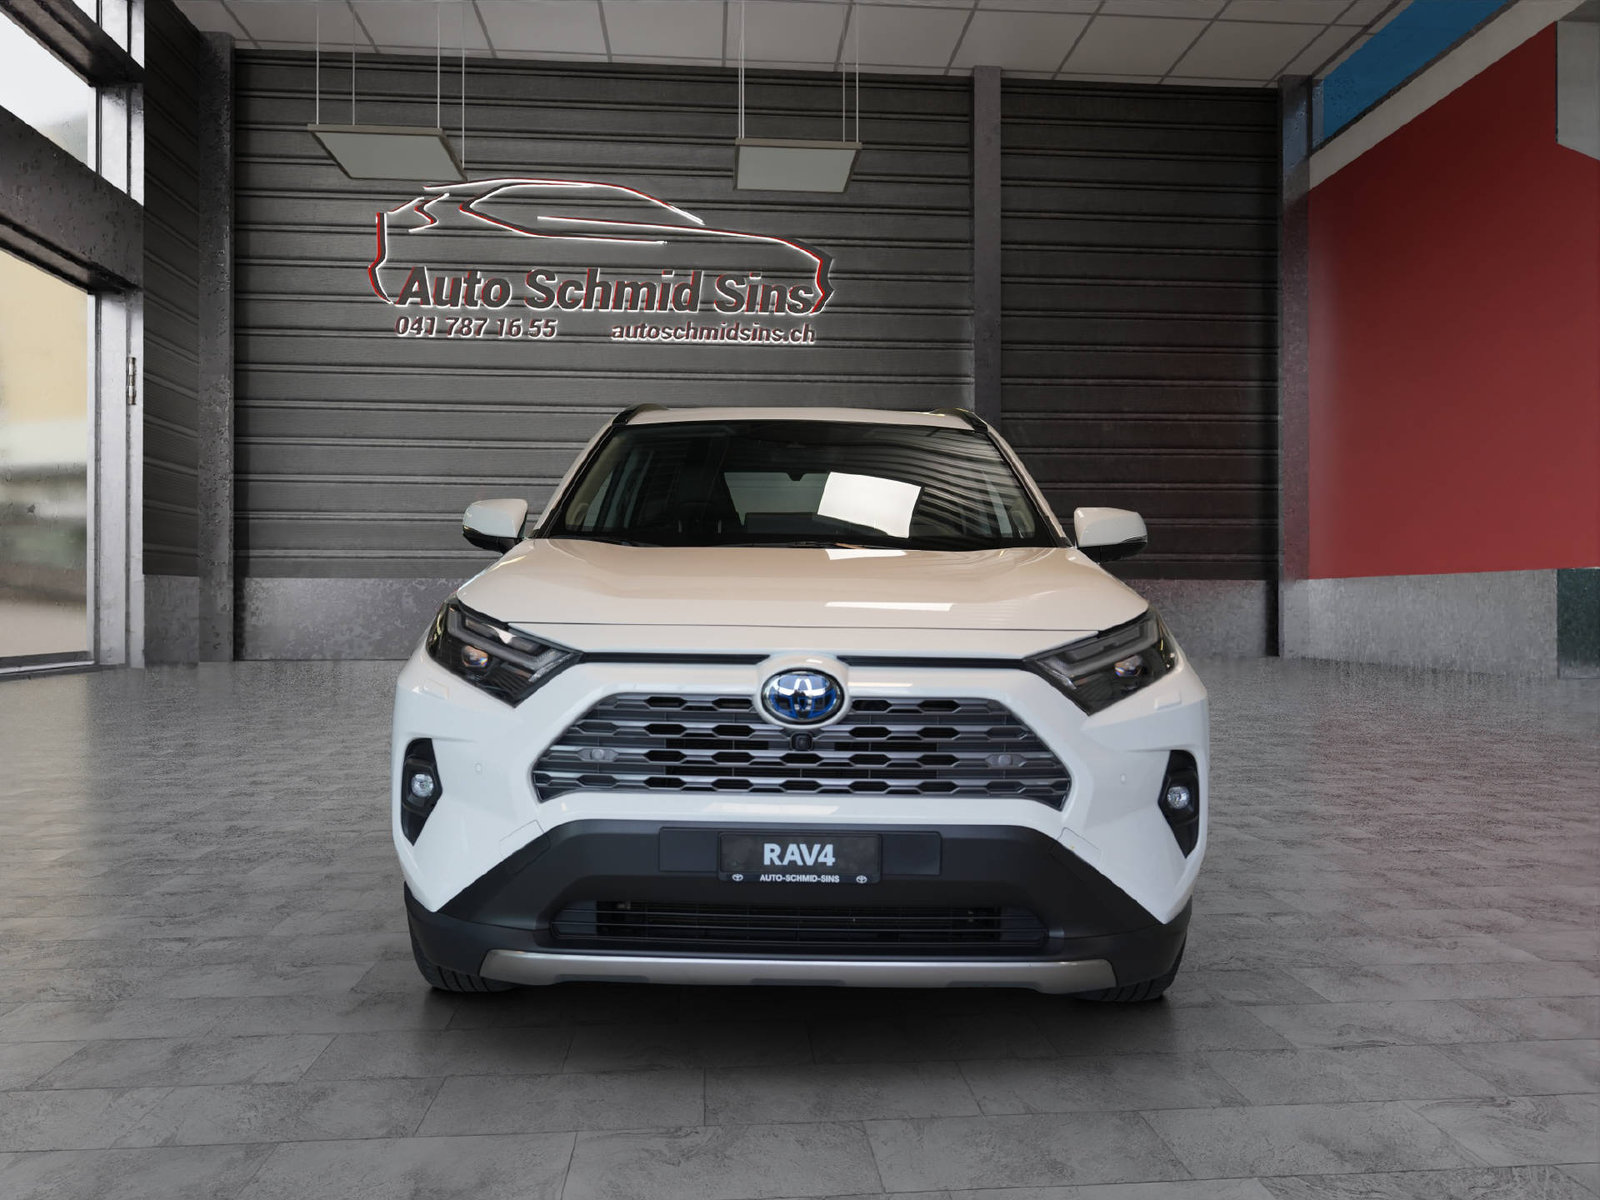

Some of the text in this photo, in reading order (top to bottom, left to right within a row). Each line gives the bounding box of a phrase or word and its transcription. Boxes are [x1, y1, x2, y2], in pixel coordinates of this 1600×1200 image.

[396, 267, 814, 316] Auto Schmid Sins
[395, 316, 558, 339] 041 787 16 55
[610, 321, 816, 344] autoschmidsins.ch
[763, 843, 836, 866] RAV4
[760, 874, 840, 883] AUTO-SCHMID-SINS
